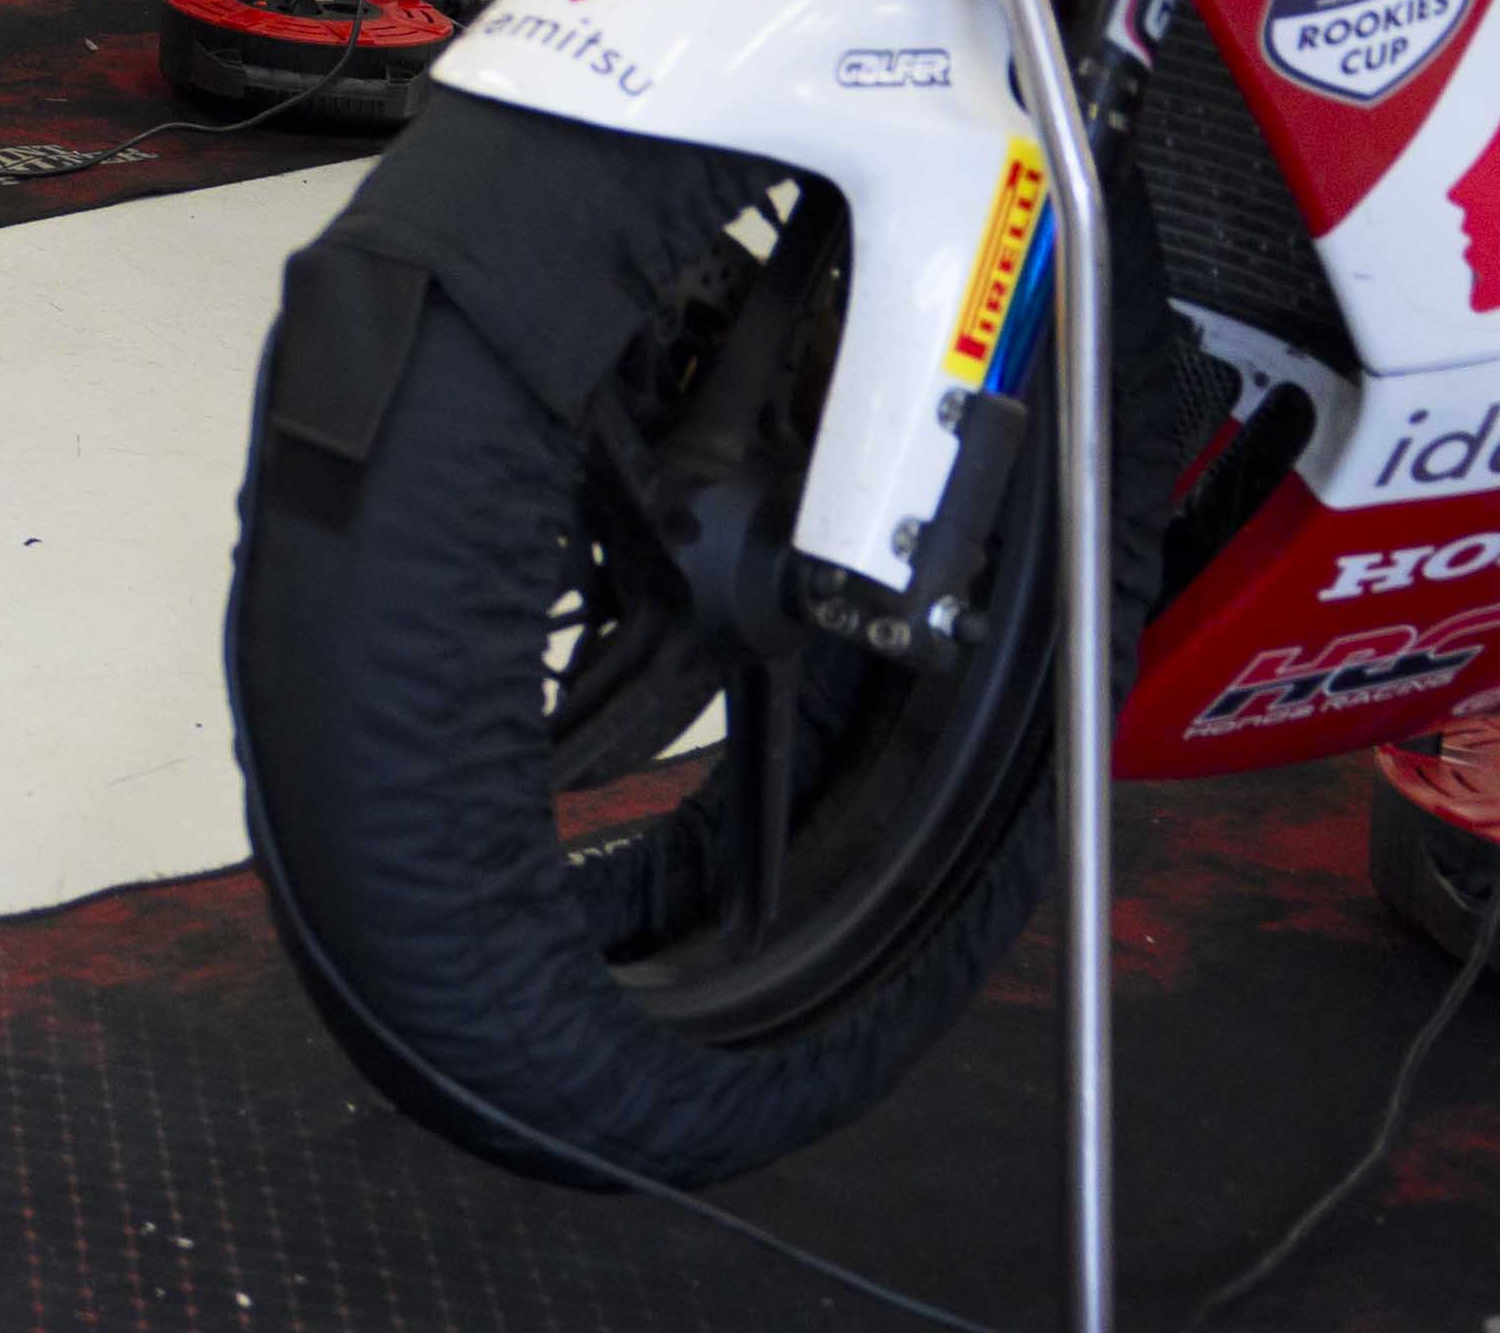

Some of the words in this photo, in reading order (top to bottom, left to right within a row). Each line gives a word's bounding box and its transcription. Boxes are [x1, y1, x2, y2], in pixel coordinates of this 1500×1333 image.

[485, 13, 654, 99] emitsu
[1340, 36, 1409, 77] CUP
[951, 158, 1041, 363] PIRELLI
[1197, 613, 1500, 723] HRC
